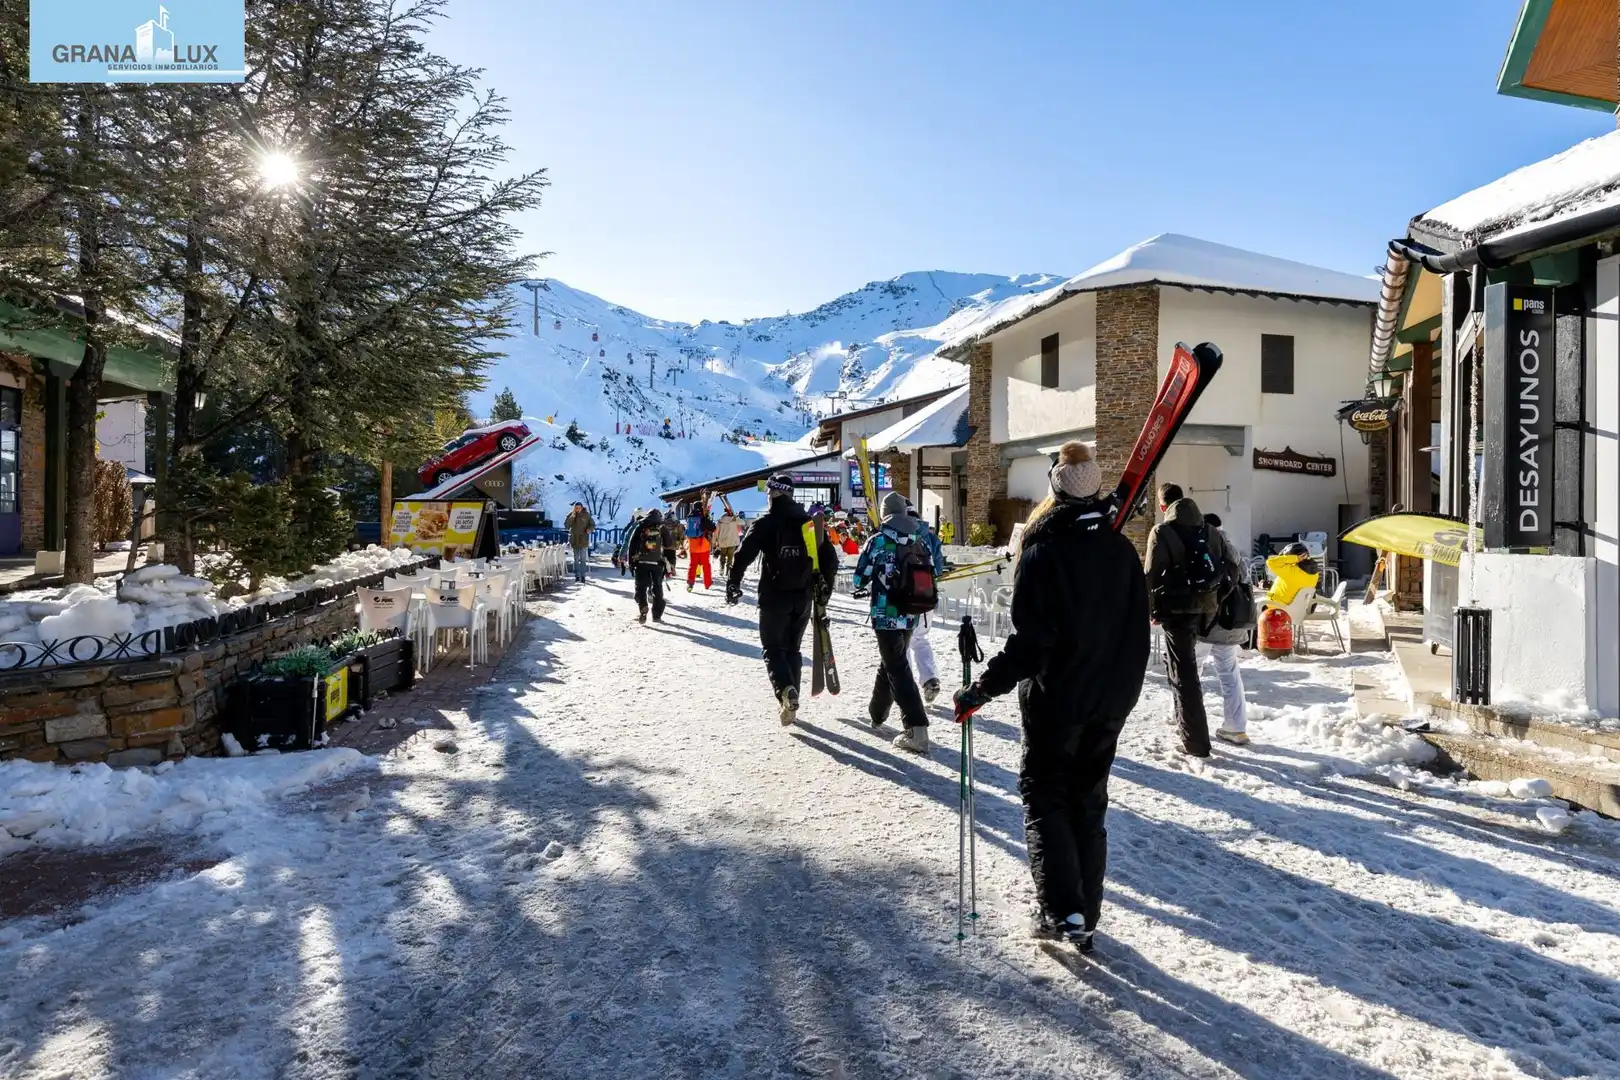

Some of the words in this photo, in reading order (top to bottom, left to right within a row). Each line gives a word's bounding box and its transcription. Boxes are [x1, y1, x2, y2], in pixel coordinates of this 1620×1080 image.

[1523, 299, 1545, 311] pans
[1518, 329, 1540, 532] DESAYUNOS
[1257, 456, 1304, 470] SNOWBOARD
[1305, 461, 1334, 473] CENTER
